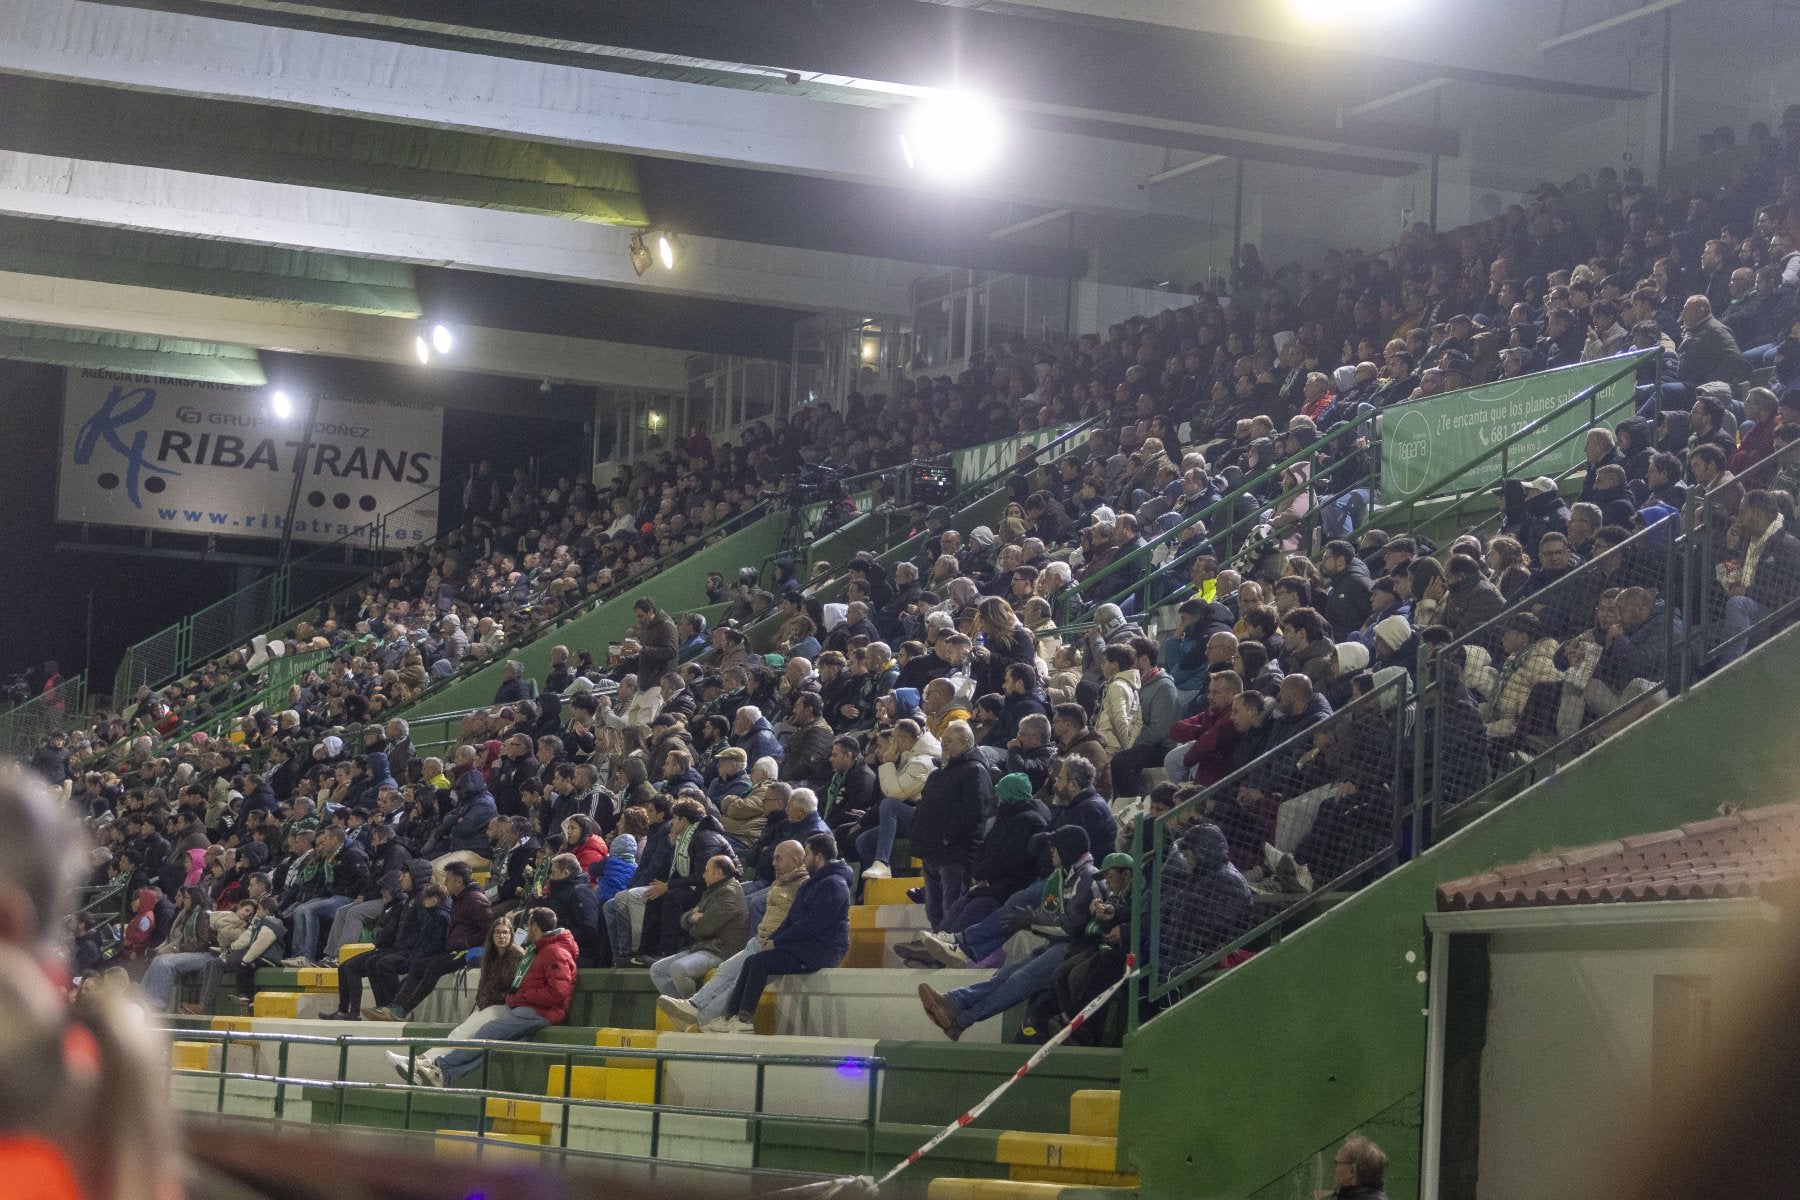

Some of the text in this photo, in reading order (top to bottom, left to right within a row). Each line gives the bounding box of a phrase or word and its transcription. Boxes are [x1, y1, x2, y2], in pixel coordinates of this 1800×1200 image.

[1453, 410, 1488, 428] encanta
[1490, 406, 1507, 425] que
[1509, 402, 1523, 416] los
[1525, 396, 1555, 418] planes
[156, 429, 432, 484] RIBATRANS
